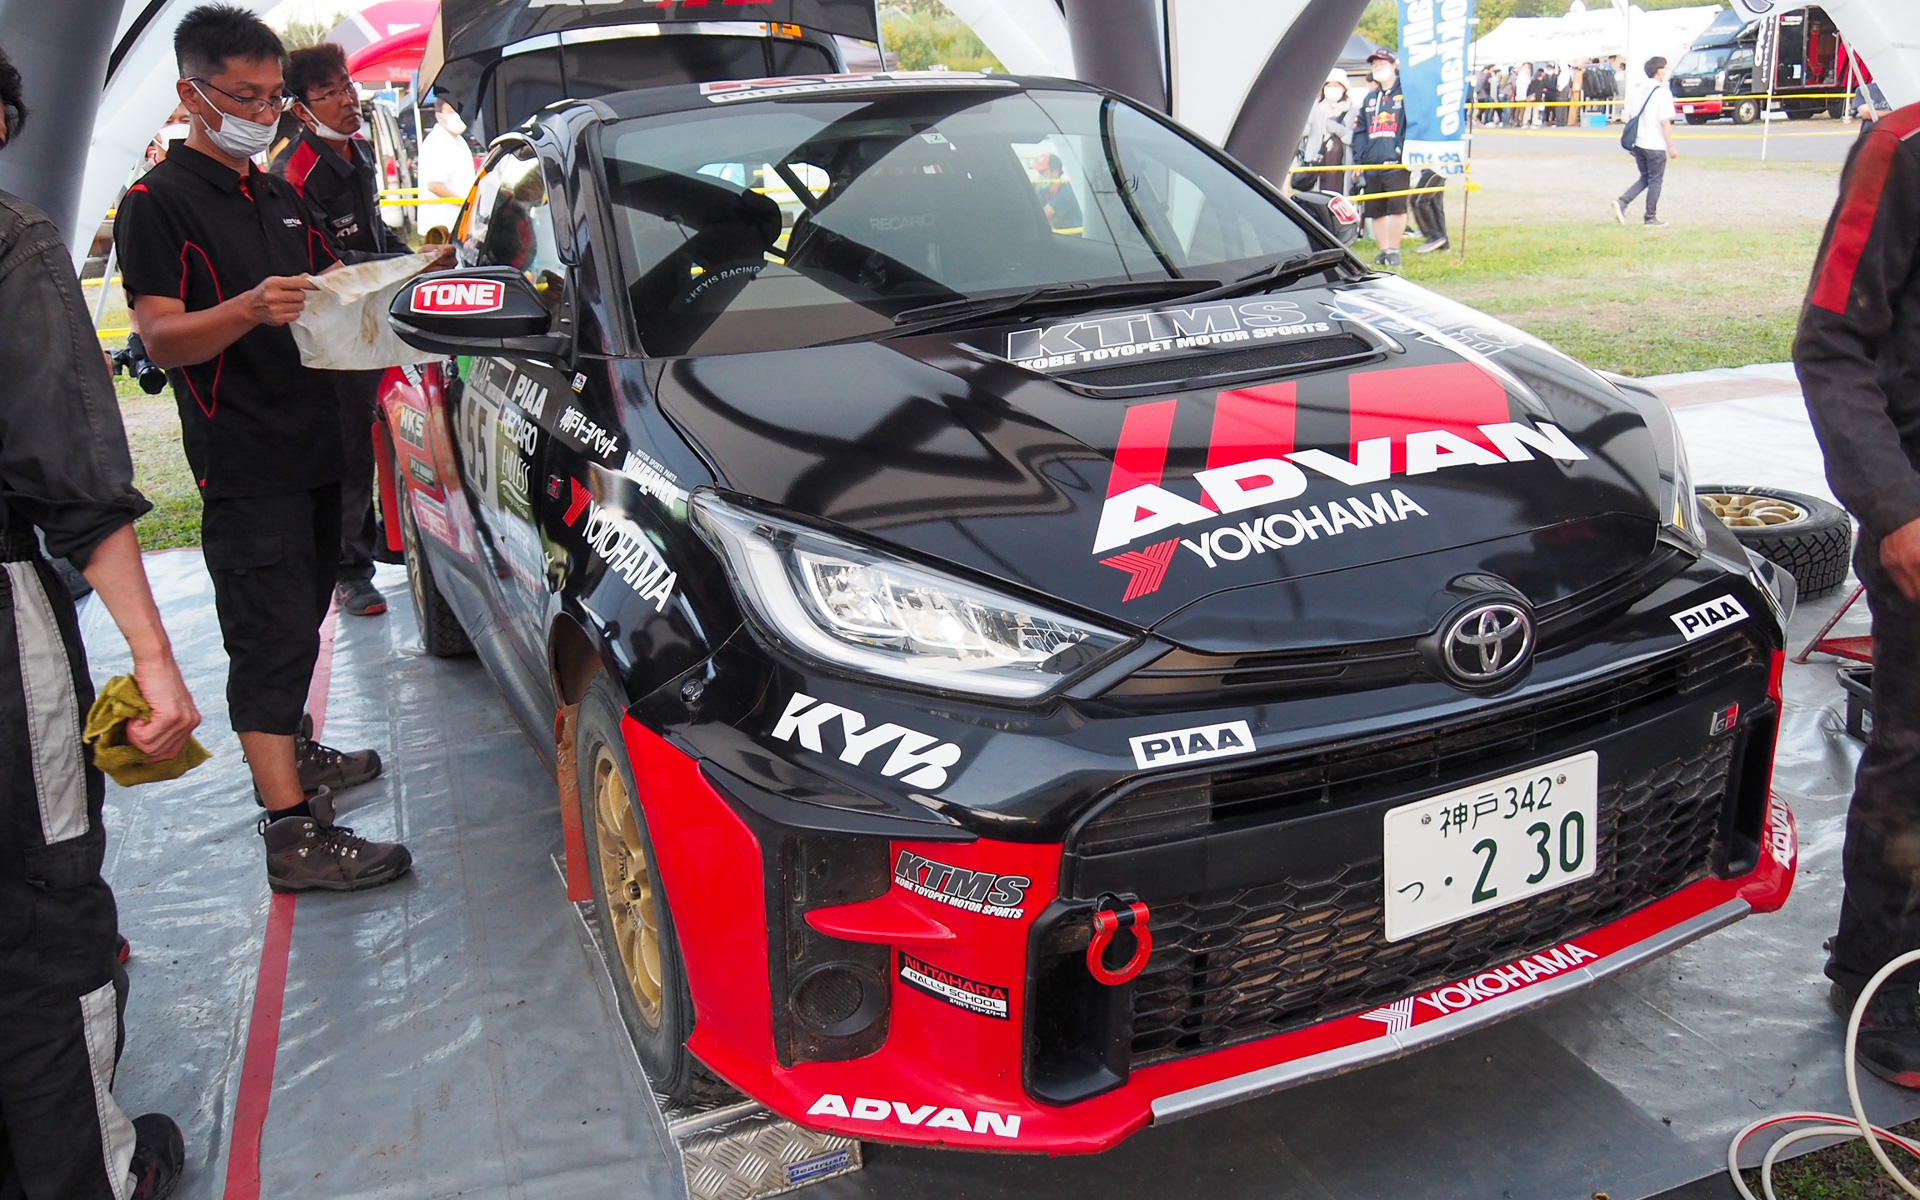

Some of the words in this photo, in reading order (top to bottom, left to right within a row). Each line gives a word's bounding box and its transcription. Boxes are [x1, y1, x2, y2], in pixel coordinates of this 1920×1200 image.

[420, 284, 496, 307] TONE
[720, 265, 760, 280] RACING
[1007, 300, 1308, 362] KTMS
[1018, 353, 1077, 370] KOBE
[1080, 339, 1173, 363] TOYOPET
[1176, 330, 1250, 349] MOTOR
[1252, 322, 1330, 339] SPORTS
[512, 373, 549, 420] PIAA
[402, 406, 424, 438] HKS
[501, 406, 538, 457] RECARO
[559, 405, 619, 459] 神戸トヨペット
[502, 445, 531, 495] ENDLESS
[649, 457, 665, 474] SPORTS
[663, 468, 678, 483] PARTS
[1092, 421, 1589, 555] ADVAN
[1180, 488, 1429, 568] YOKOHAMA
[582, 500, 678, 613] YOKOHAMA
[1679, 601, 1741, 634] PIAA
[771, 691, 962, 790] KYB
[1714, 710, 1736, 733] GR
[1140, 728, 1245, 762] PIAA
[1439, 792, 1498, 838] 神戸
[1503, 776, 1553, 819] 342
[894, 850, 1031, 907] KTMS
[895, 875, 914, 892] KOBE
[914, 884, 951, 904] TOYOPET
[948, 894, 984, 914] MOTOR
[981, 903, 1025, 920] SPORTS
[1397, 881, 1425, 903] つ
[904, 955, 1006, 1000] NUTAHARA
[909, 971, 945, 992] RALLY
[949, 988, 1001, 1009] SCHOOL
[1416, 943, 1599, 1015] YOKOHAMA
[806, 1093, 1022, 1138] ADVAN
[791, 1154, 847, 1177] Beatrush
